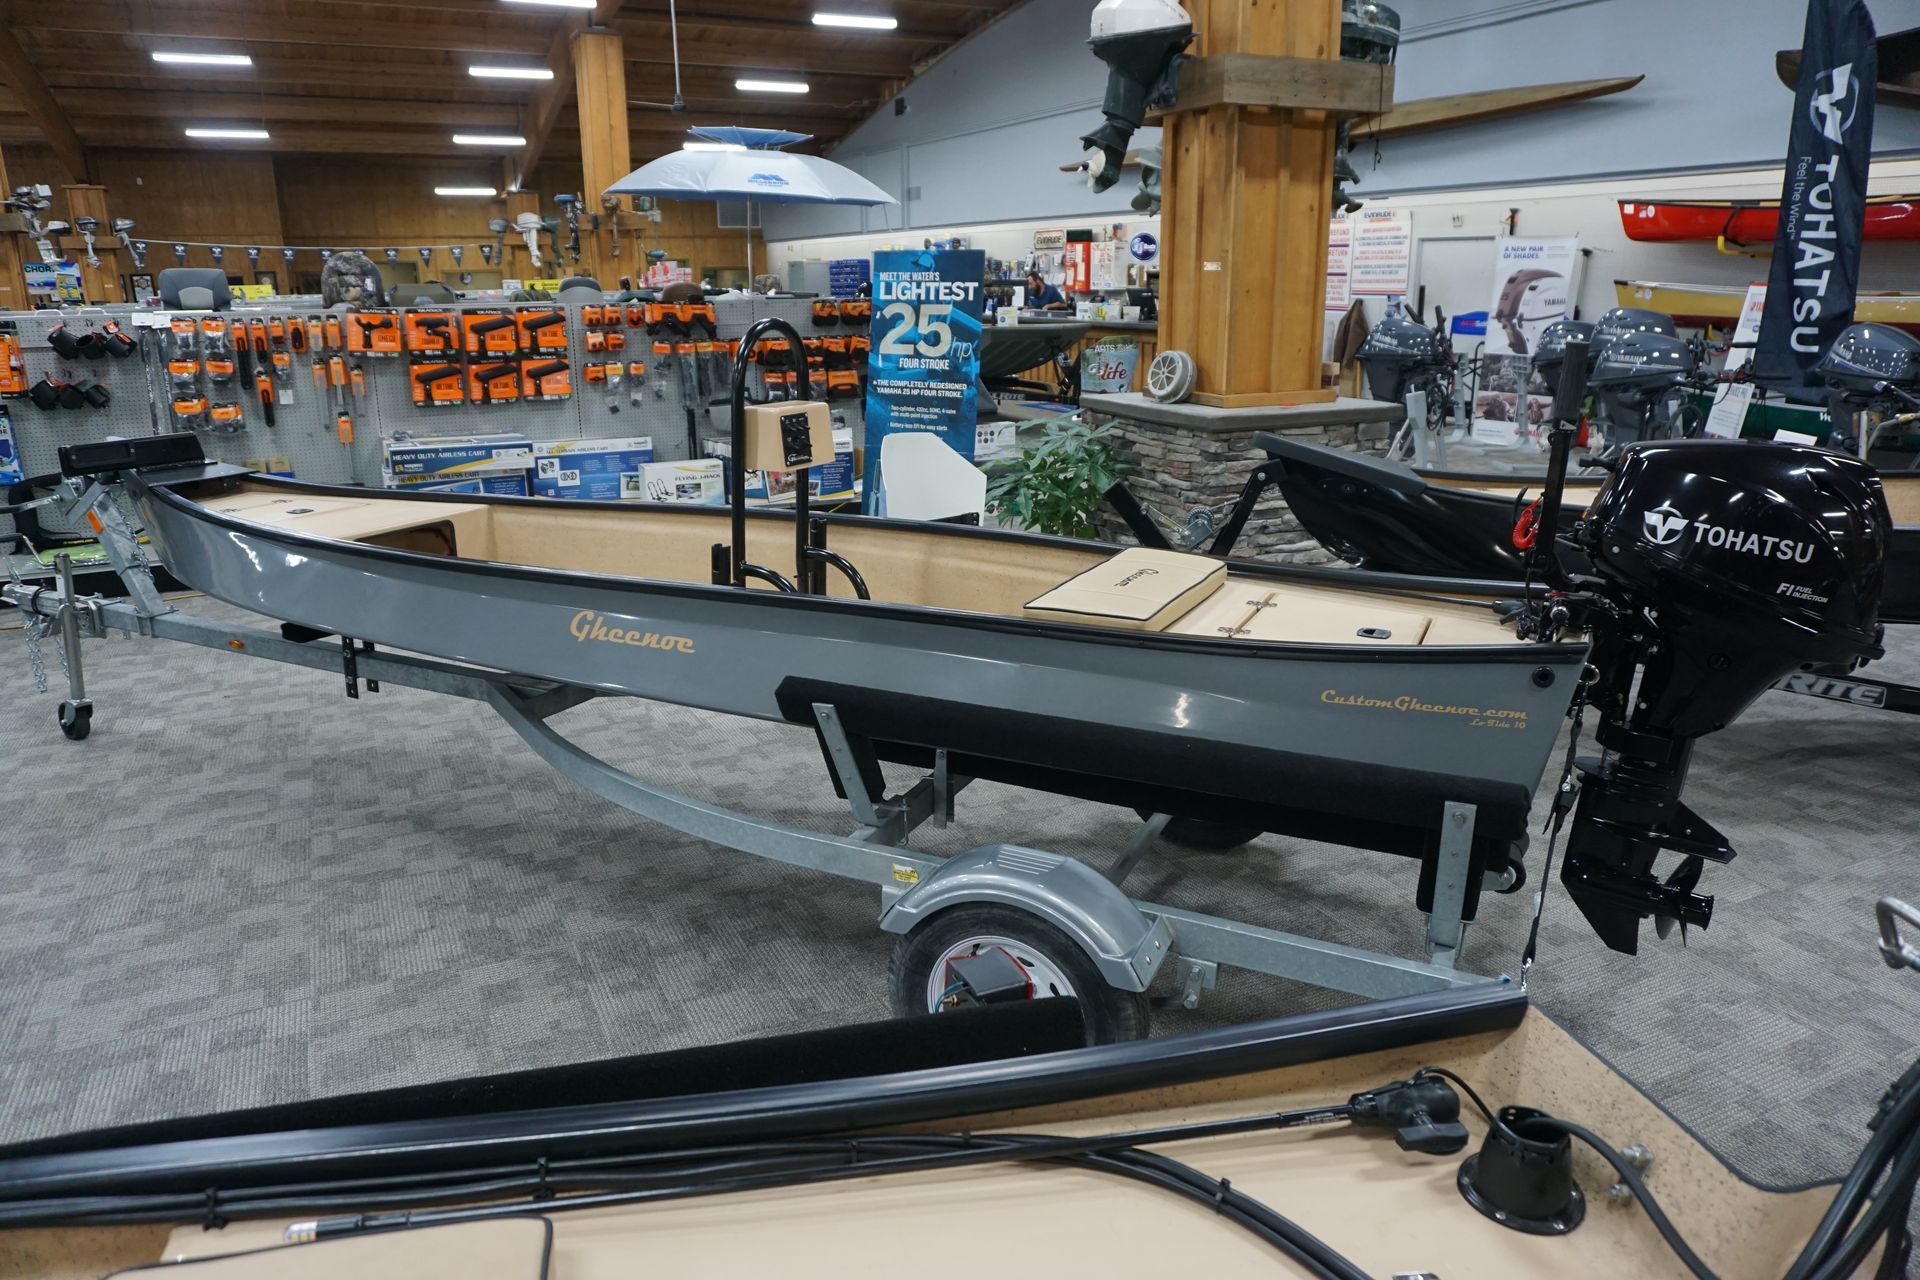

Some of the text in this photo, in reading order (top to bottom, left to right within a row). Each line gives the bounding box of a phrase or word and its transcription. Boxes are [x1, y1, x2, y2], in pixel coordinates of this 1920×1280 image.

[1796, 156, 1812, 180] Feel
[1792, 181, 1806, 201] the
[1790, 154, 1839, 353] TOHATSU
[880, 271, 940, 280] MEET THE WATER'S
[880, 281, 979, 300] LIGHTEST
[950, 336, 972, 363] hp
[899, 358, 950, 370] FOUR STROKE
[1617, 354, 1644, 363] YAMAHA
[890, 380, 928, 388] COMPLETELY
[930, 381, 967, 390] REDESIGNED
[937, 390, 963, 398] STROKE.
[1693, 521, 1815, 564] TOHATSU
[1775, 582, 1812, 596] FI FUEL
[1792, 592, 1828, 604] INJECTION
[569, 610, 696, 654] Gheenoe
[1514, 721, 1526, 730] 10
